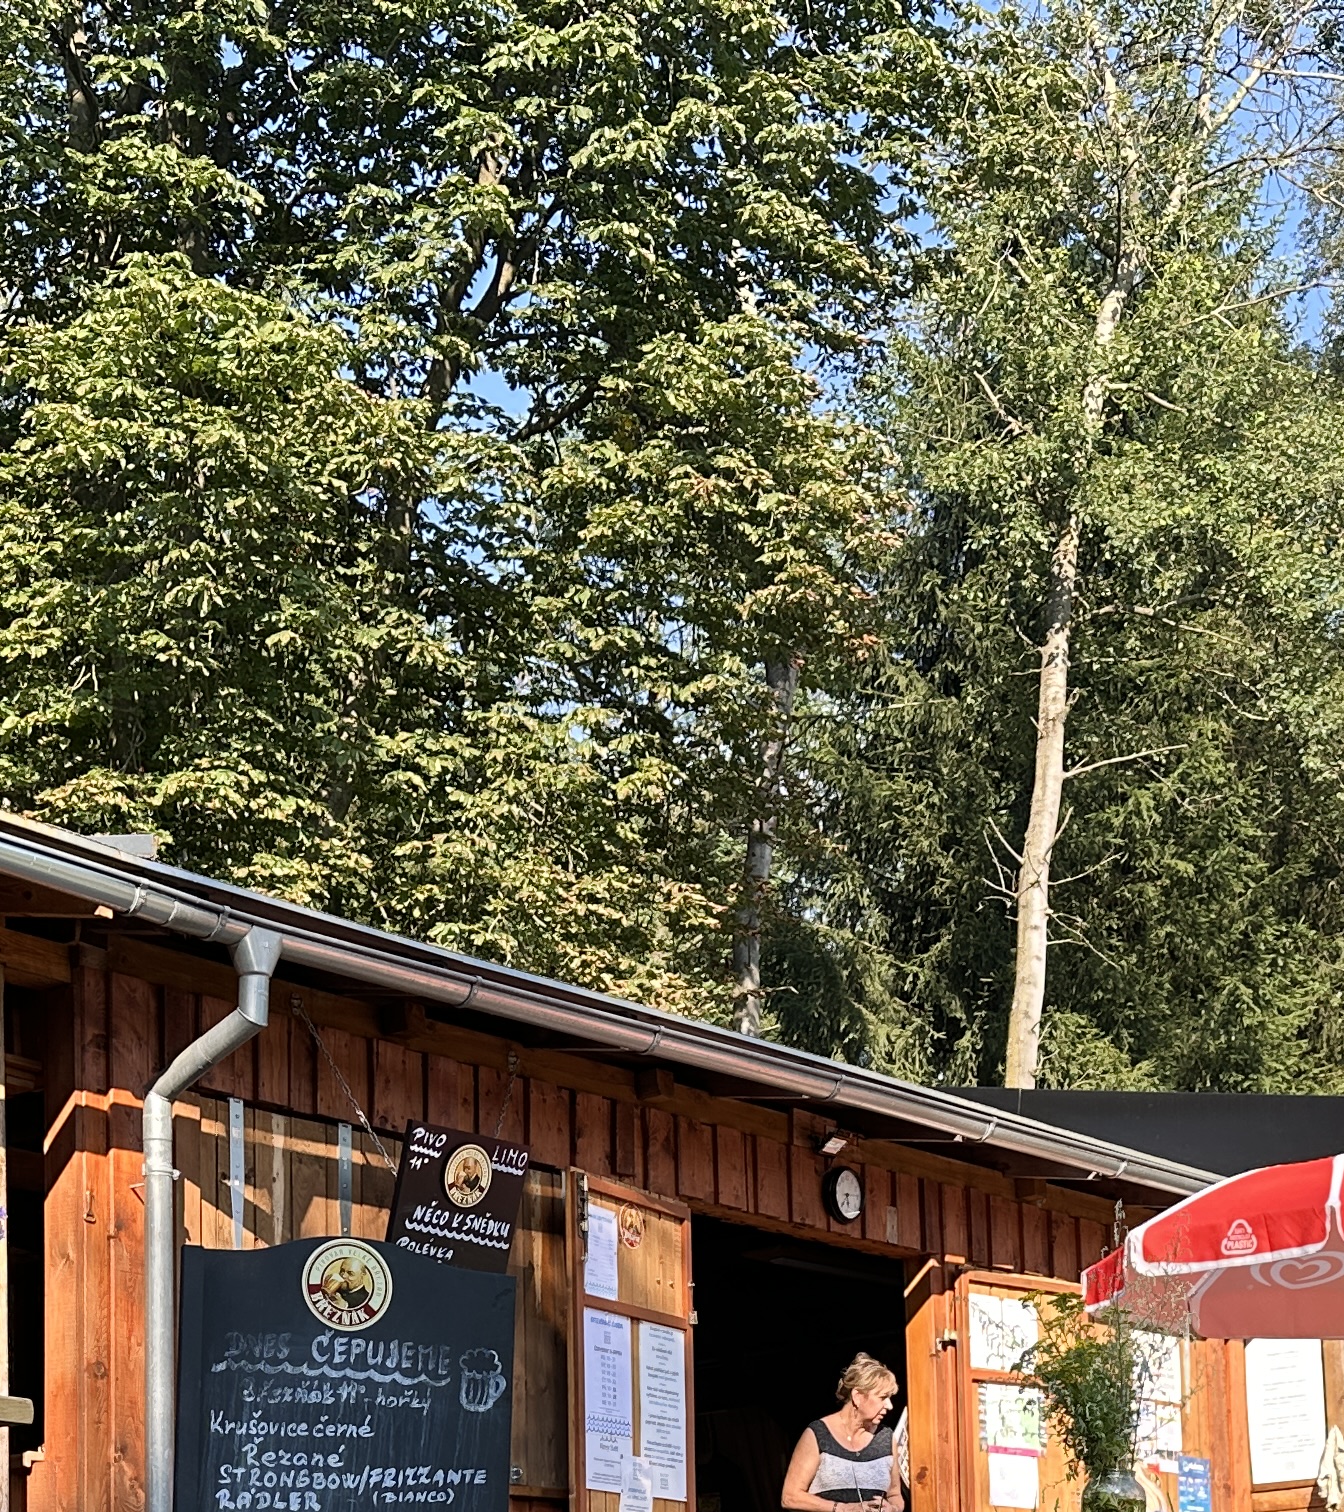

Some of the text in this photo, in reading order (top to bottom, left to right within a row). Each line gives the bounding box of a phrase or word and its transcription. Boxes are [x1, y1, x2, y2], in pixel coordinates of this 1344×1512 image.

[412, 1127, 447, 1148] PIVO
[492, 1145, 528, 1167] LIMO
[412, 1200, 511, 1238] NĚCO K SNĚDKU
[395, 1236, 454, 1261] POLÉVKA
[224, 1329, 451, 1375] DNES ČEPUJEME
[375, 1387, 432, 1416] hořký
[210, 1409, 376, 1438] Krušovice černé
[241, 1437, 346, 1468] Řezané
[215, 1487, 456, 1512] RÁDLER (BIANCO)
